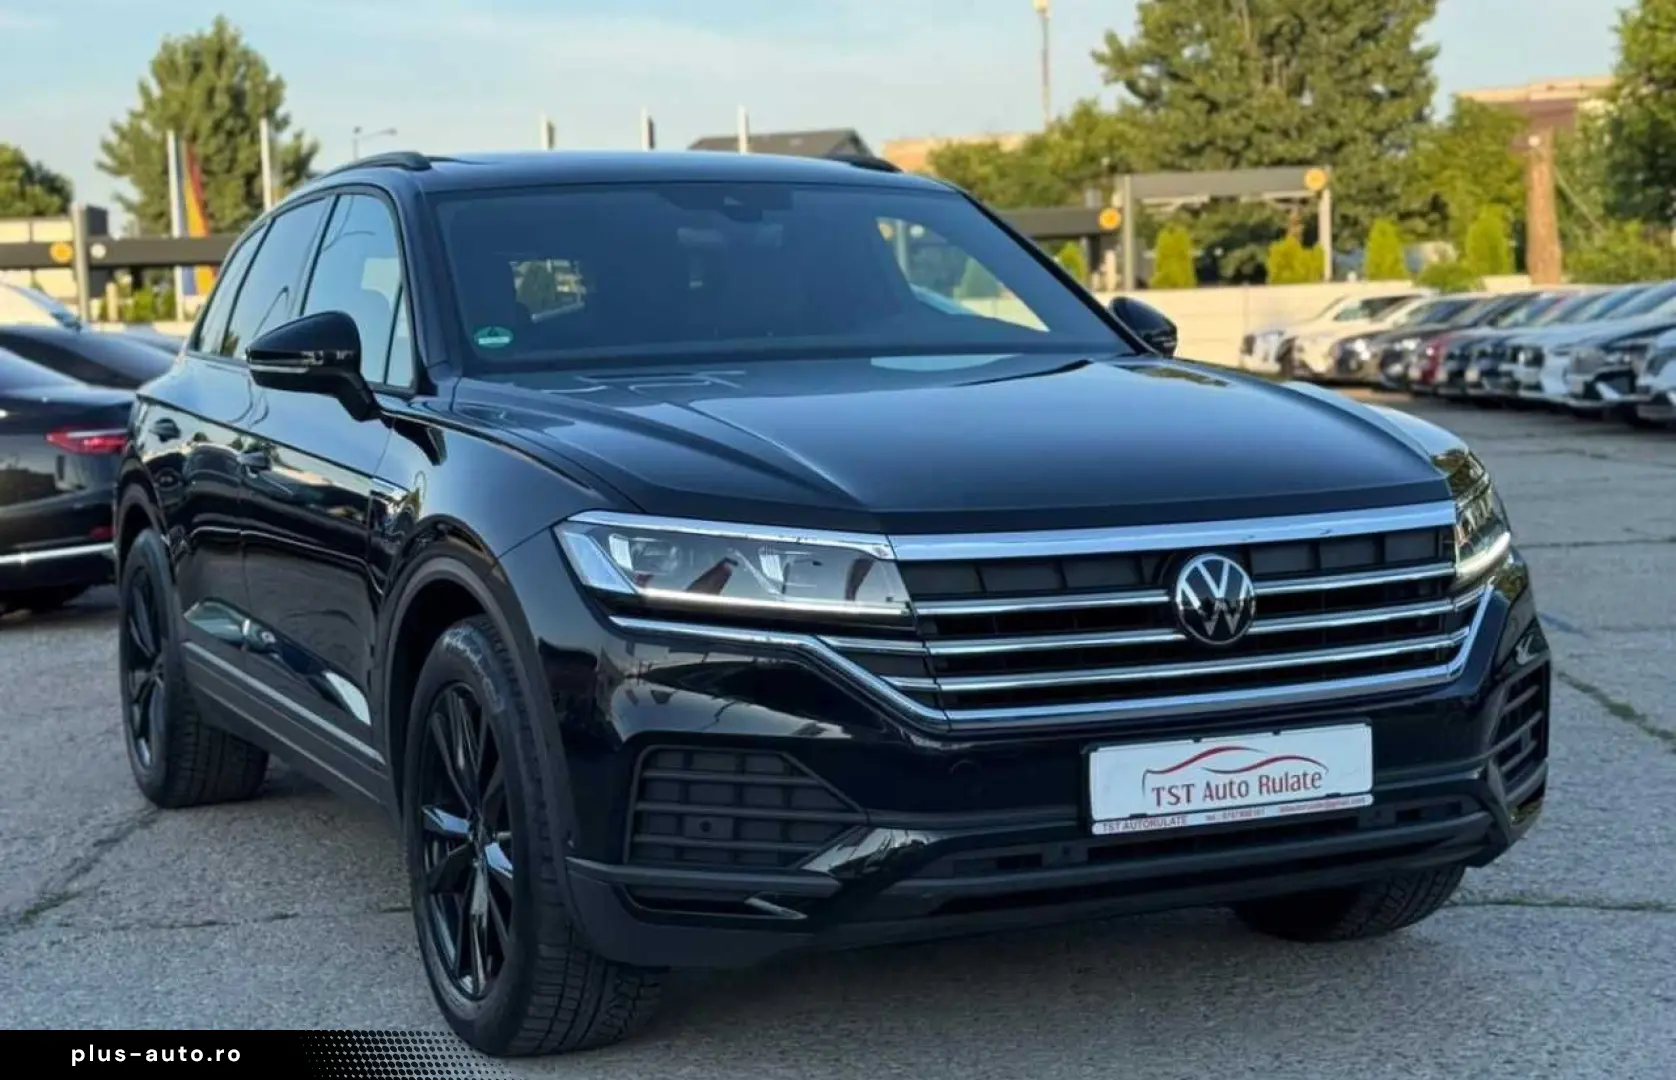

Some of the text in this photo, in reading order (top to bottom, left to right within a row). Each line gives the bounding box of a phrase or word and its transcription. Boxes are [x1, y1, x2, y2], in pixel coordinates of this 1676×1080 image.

[1152, 770, 1322, 807] TST Auto Rulate
[1103, 814, 1187, 832] TST AUTORULATE
